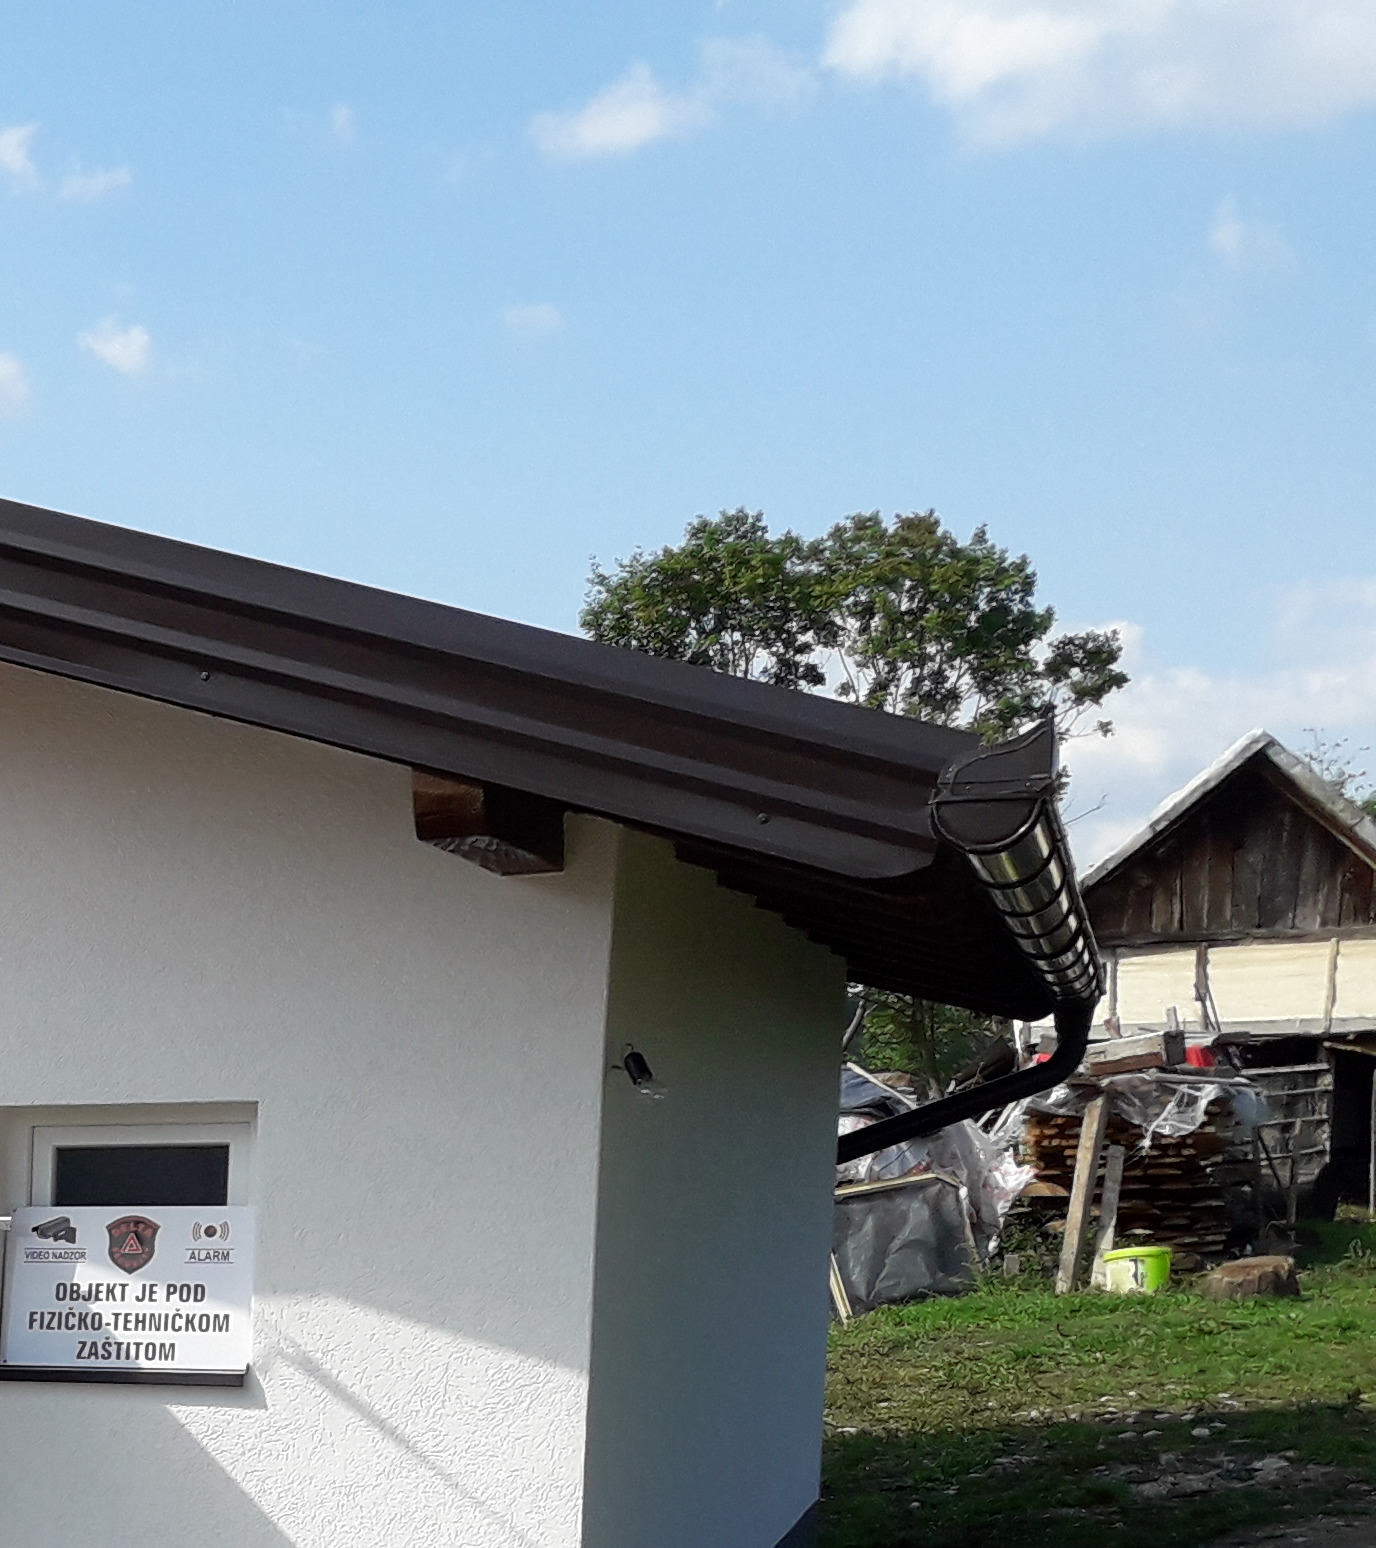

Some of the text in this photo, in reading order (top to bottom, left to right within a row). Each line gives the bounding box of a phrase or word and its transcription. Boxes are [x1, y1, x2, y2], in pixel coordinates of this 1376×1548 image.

[24, 1250, 87, 1261] VIDEO NADZOR
[188, 1250, 230, 1262] ALARM
[55, 1282, 206, 1303] OBJEKT JE POD
[28, 1306, 230, 1333] FIZIČKO-TEHNIČKOM
[76, 1337, 176, 1362] ZAŠTITOM
